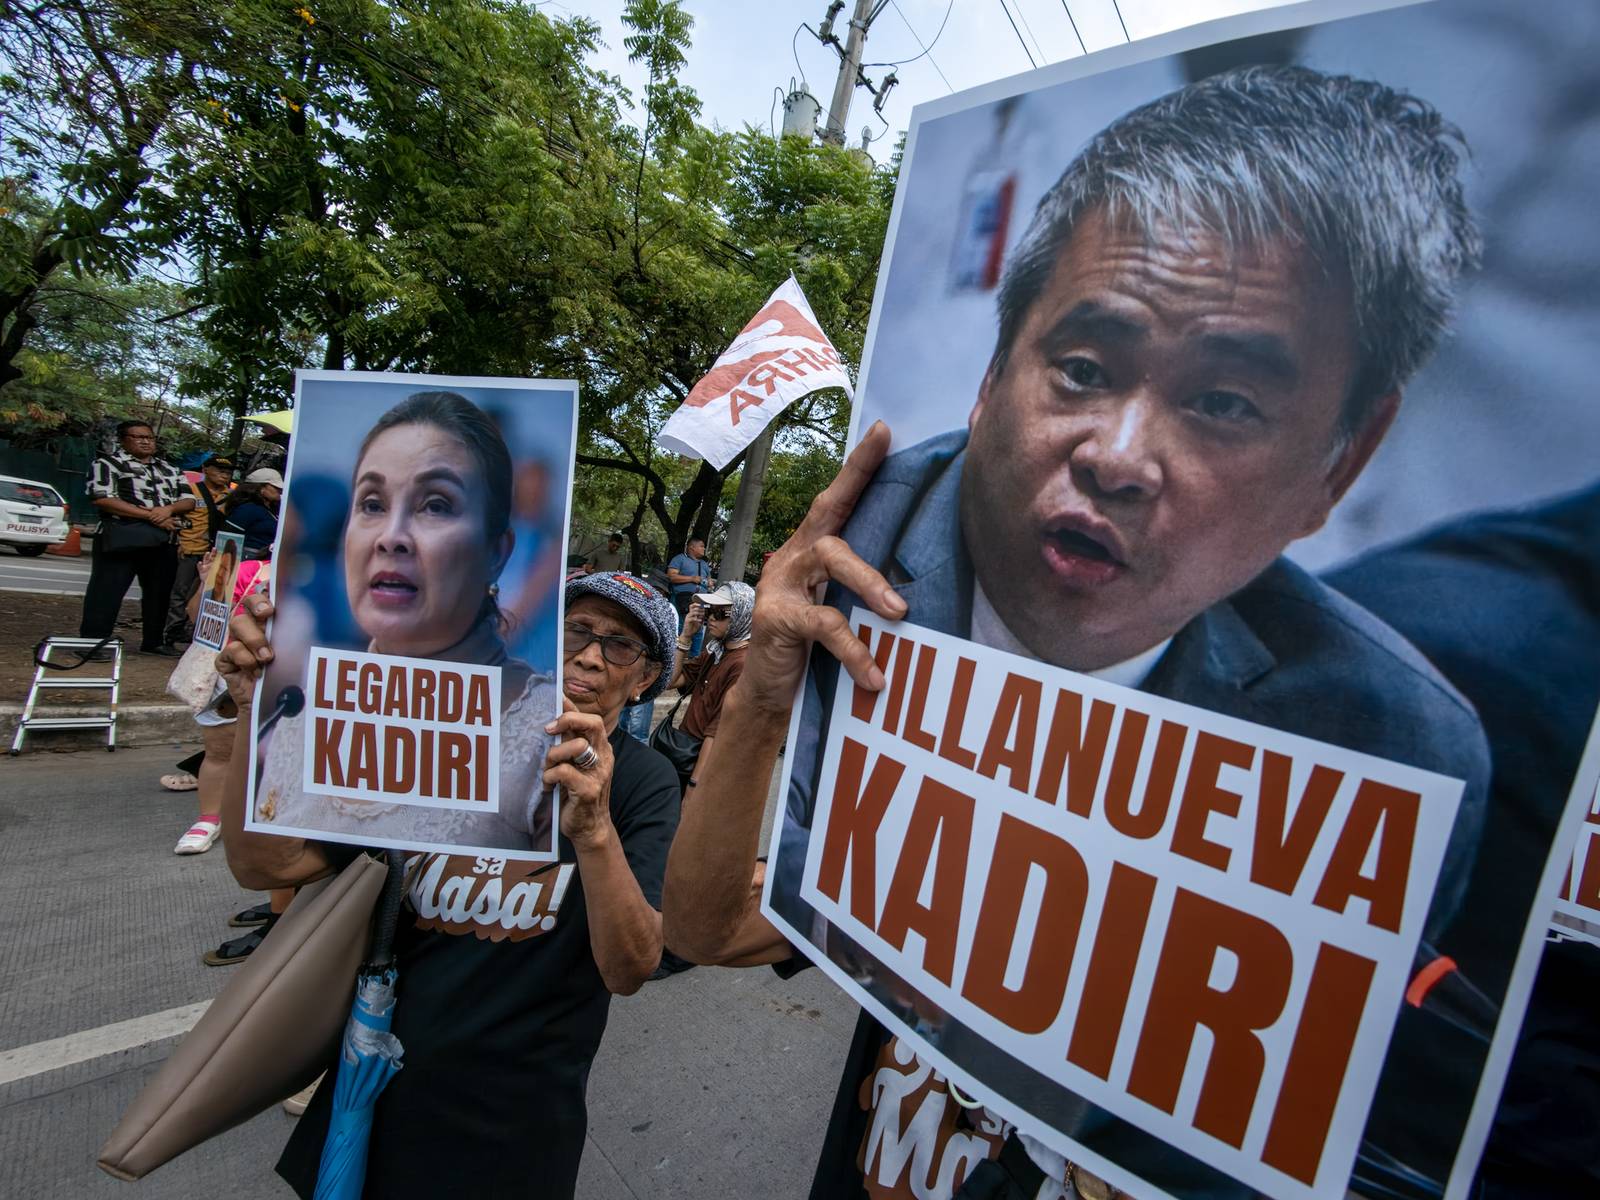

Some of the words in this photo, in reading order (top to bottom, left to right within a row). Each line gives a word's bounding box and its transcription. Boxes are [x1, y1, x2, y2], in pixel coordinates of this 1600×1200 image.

[6, 523, 50, 535] PULISYA
[314, 657, 492, 727] LEGARDA
[313, 716, 490, 802] KADIRI
[850, 623, 1423, 935] VILLANUEVA
[816, 735, 1378, 1188] KADIRI
